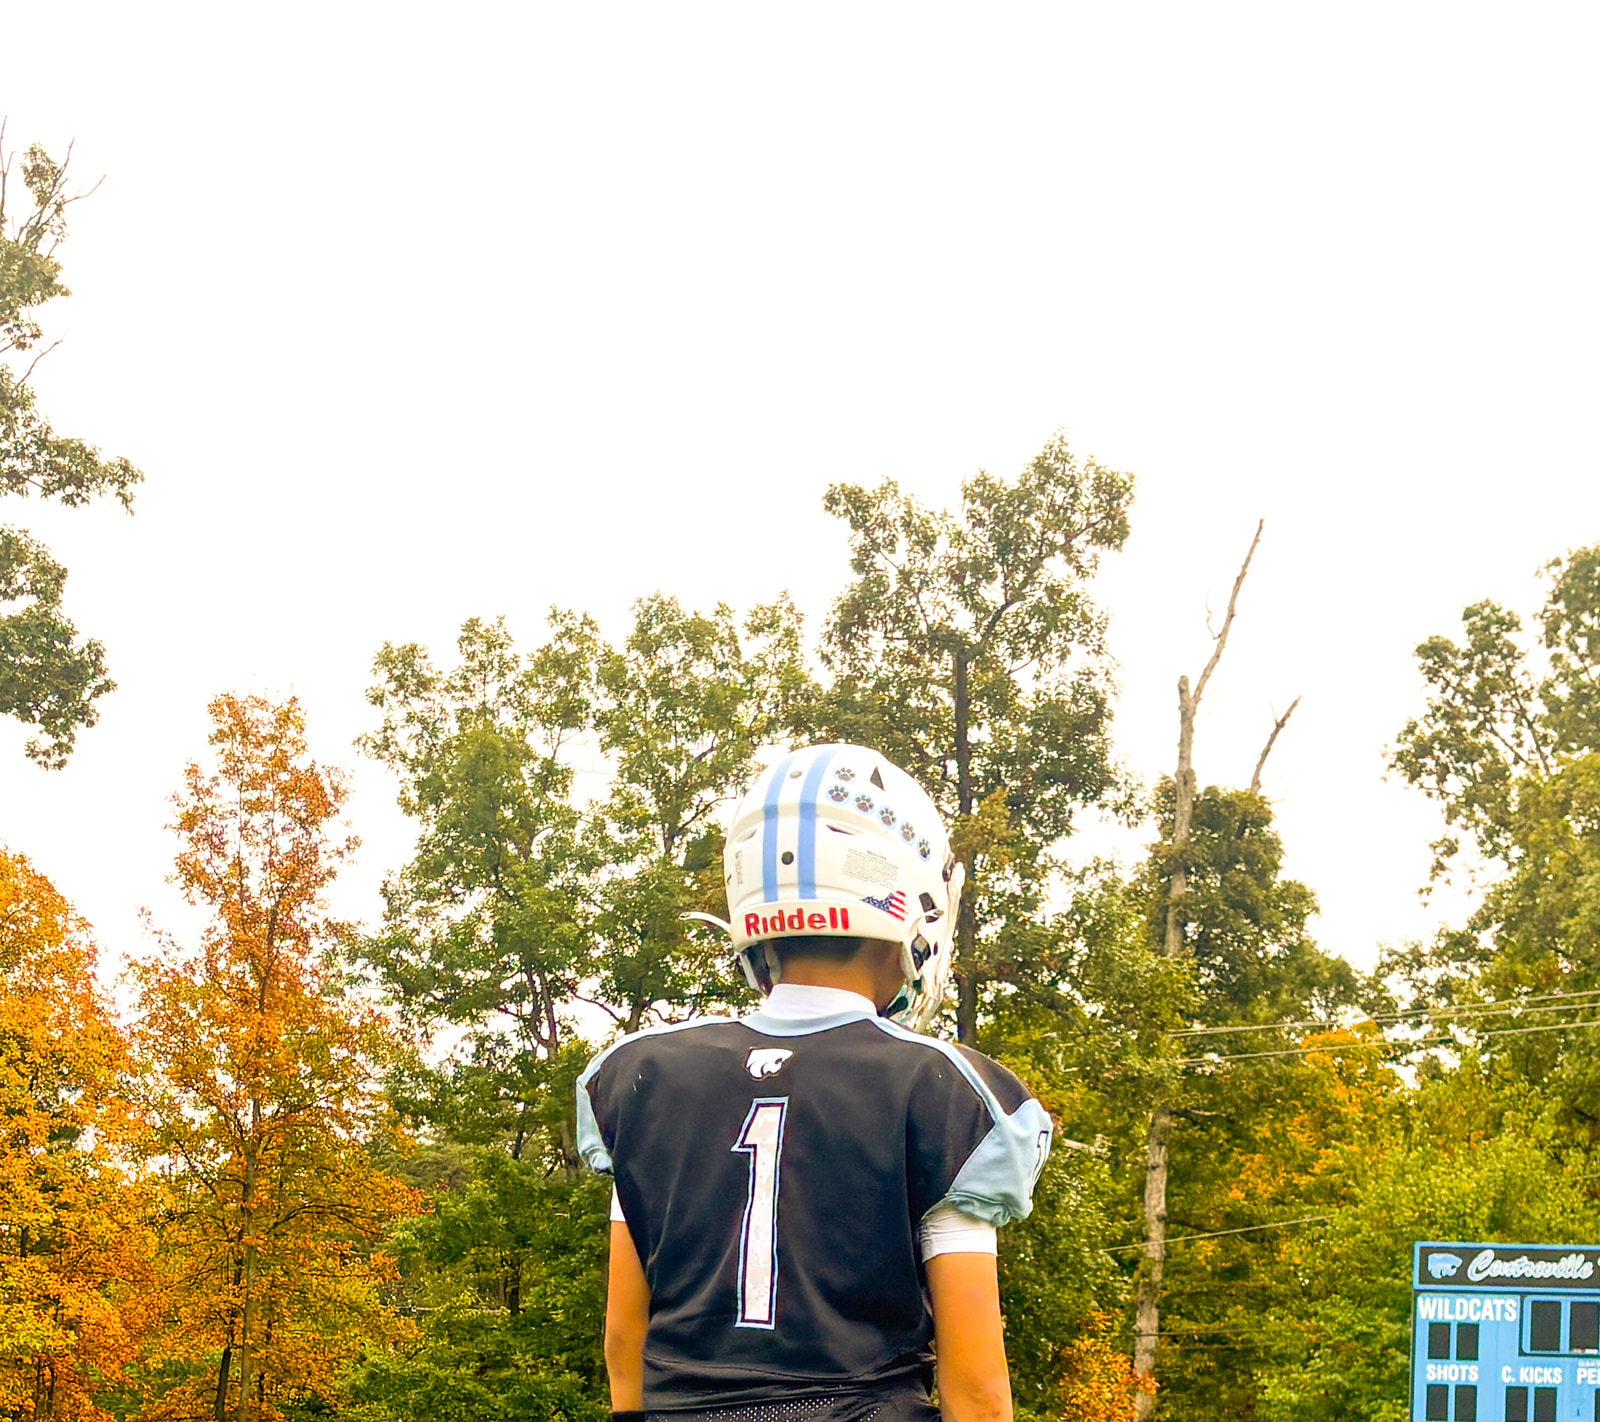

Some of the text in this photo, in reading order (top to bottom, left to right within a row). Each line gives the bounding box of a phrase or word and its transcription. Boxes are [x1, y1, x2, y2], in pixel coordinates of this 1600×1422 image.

[744, 907, 850, 938] Riddell
[731, 1096, 789, 1330] 1
[1466, 1249, 1594, 1282] Centreville
[1417, 1298, 1517, 1322] WILDCATS
[1426, 1363, 1479, 1382] SHOTS
[1501, 1366, 1563, 1385] C. KICKS
[1576, 1367, 1600, 1385] PE
